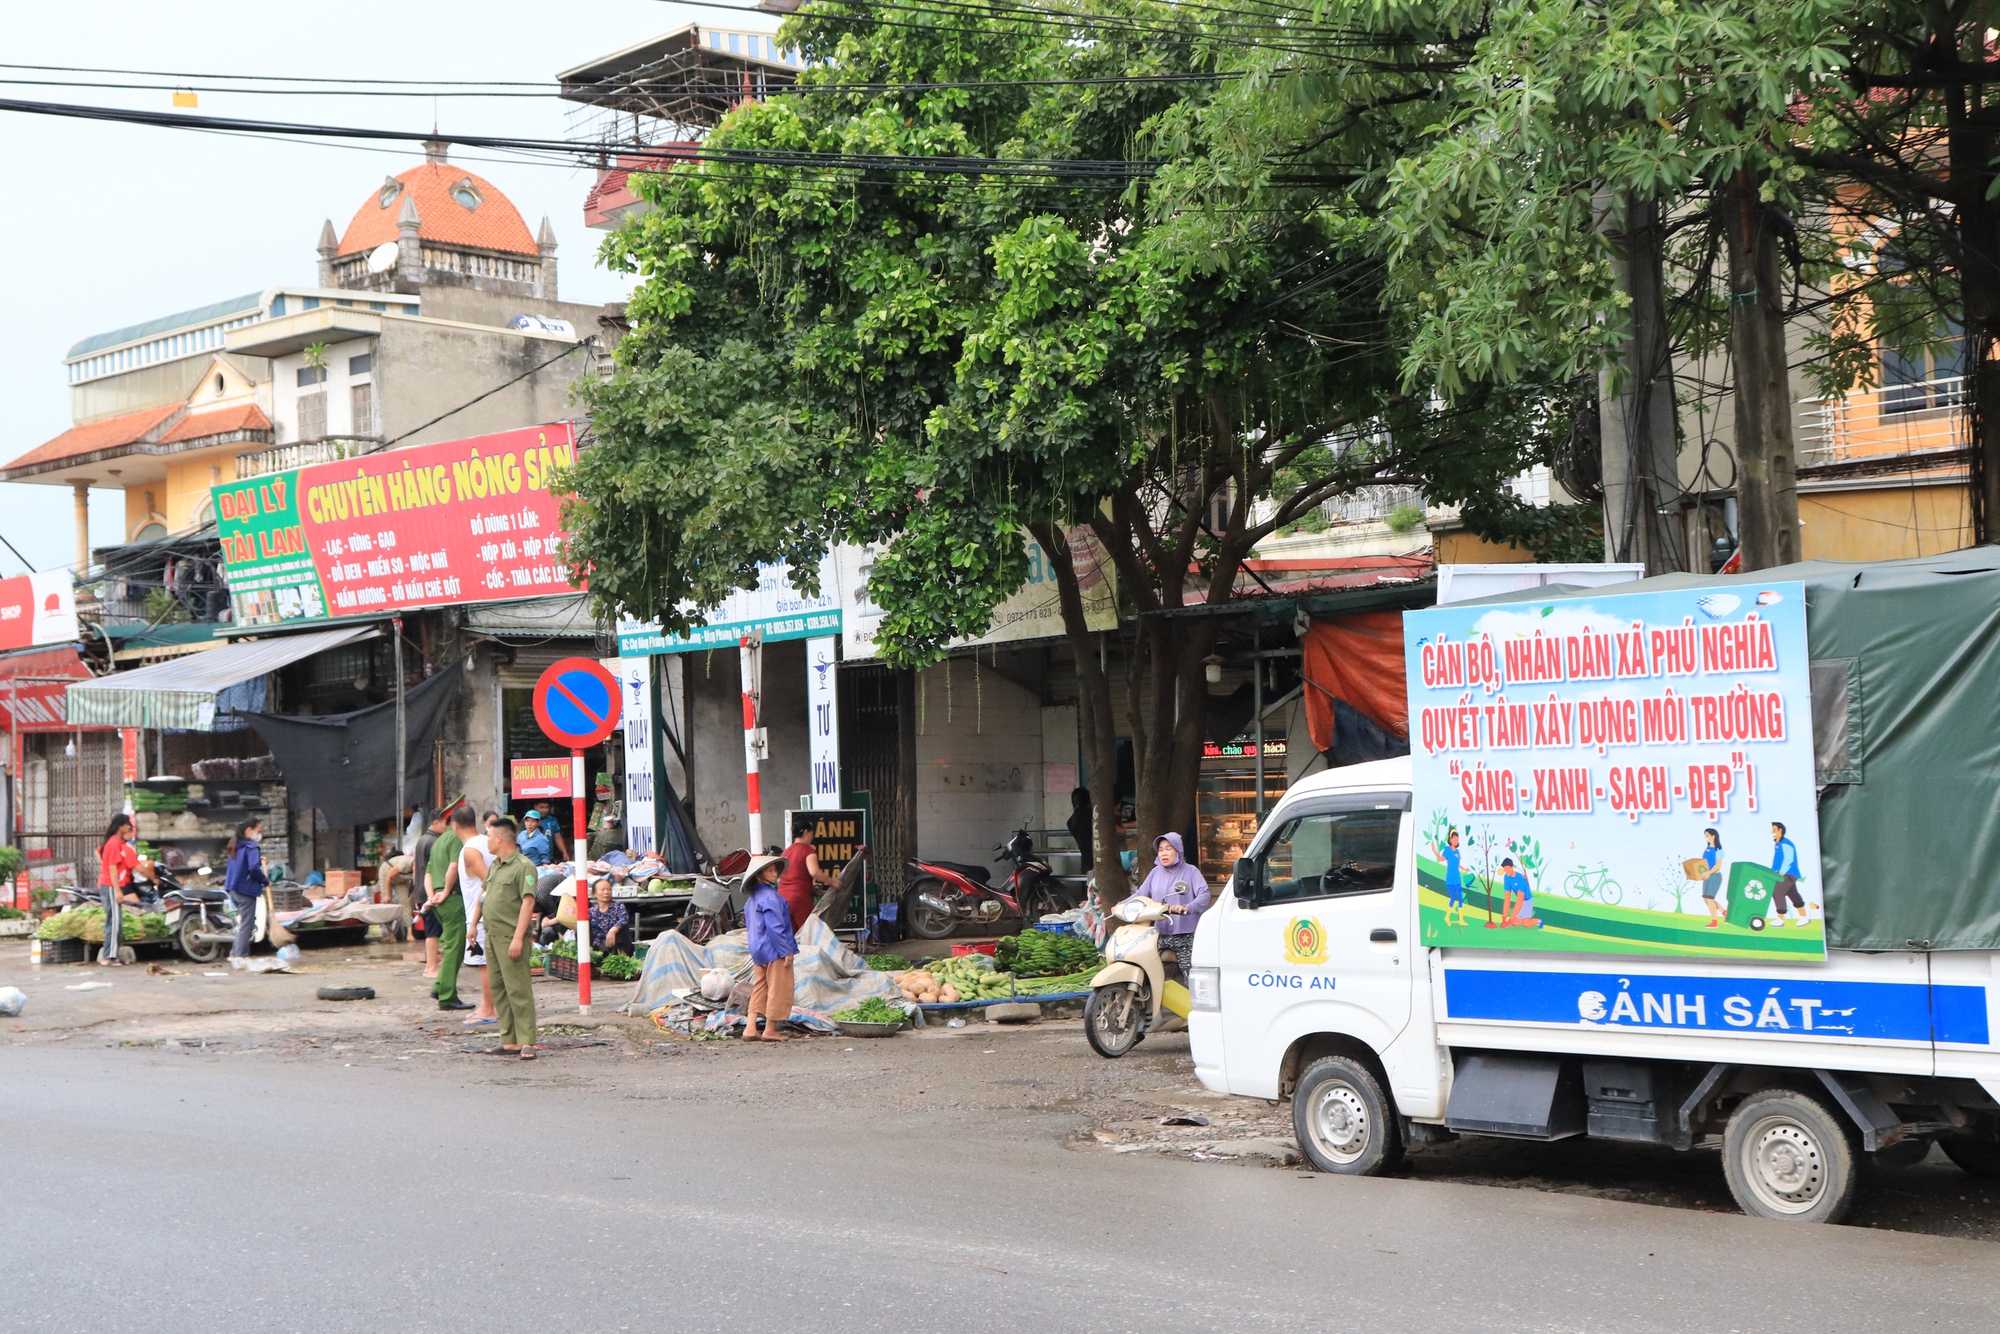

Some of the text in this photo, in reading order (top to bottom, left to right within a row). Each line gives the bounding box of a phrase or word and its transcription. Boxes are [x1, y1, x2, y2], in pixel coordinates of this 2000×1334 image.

[308, 432, 575, 524] CHUYÊN HÀNG NÔNG SẢN
[219, 476, 286, 524] ĐẠI LÝ
[484, 513, 510, 533] DÙNG
[510, 514, 516, 530] 1
[220, 525, 305, 564] TÀI LAN
[326, 538, 343, 559] LẠC
[377, 530, 396, 550] GẠO
[481, 542, 499, 564] HỘP
[500, 539, 516, 559] XÔI
[523, 536, 541, 559] HỘP
[344, 563, 362, 580] ĐEN
[367, 554, 390, 577] MIẾN
[391, 557, 404, 574] SO
[409, 551, 430, 574] MỘC
[486, 567, 504, 589] CỐC
[510, 566, 532, 586] THÌA
[532, 564, 551, 584] CÁC
[358, 587, 386, 606] HƯƠNG
[425, 577, 443, 597] CHÈ
[443, 575, 461, 599] BỘT
[1, 605, 22, 620] SHOP
[1422, 614, 1774, 692] CÁN BỘ, NHÂN DÂN XÃ PHÚ NGHĨA
[817, 700, 830, 737] TƯ
[1421, 683, 1783, 754] QUYẾT TÂM XÂY DỰNG MÔI TRƯỜNG
[1222, 743, 1243, 755] chào
[514, 762, 569, 781] CHÙA LŨNG VỊ
[628, 761, 652, 802] THUỐC
[814, 750, 836, 794] VẤN
[1533, 768, 1590, 810] XANH
[1609, 766, 1668, 820] SẠCH
[632, 826, 652, 855] MINH
[815, 818, 855, 838] ÁNH
[1248, 970, 1336, 990] CÔNG AN
[1578, 978, 1821, 1030] CẢNH SÁT
